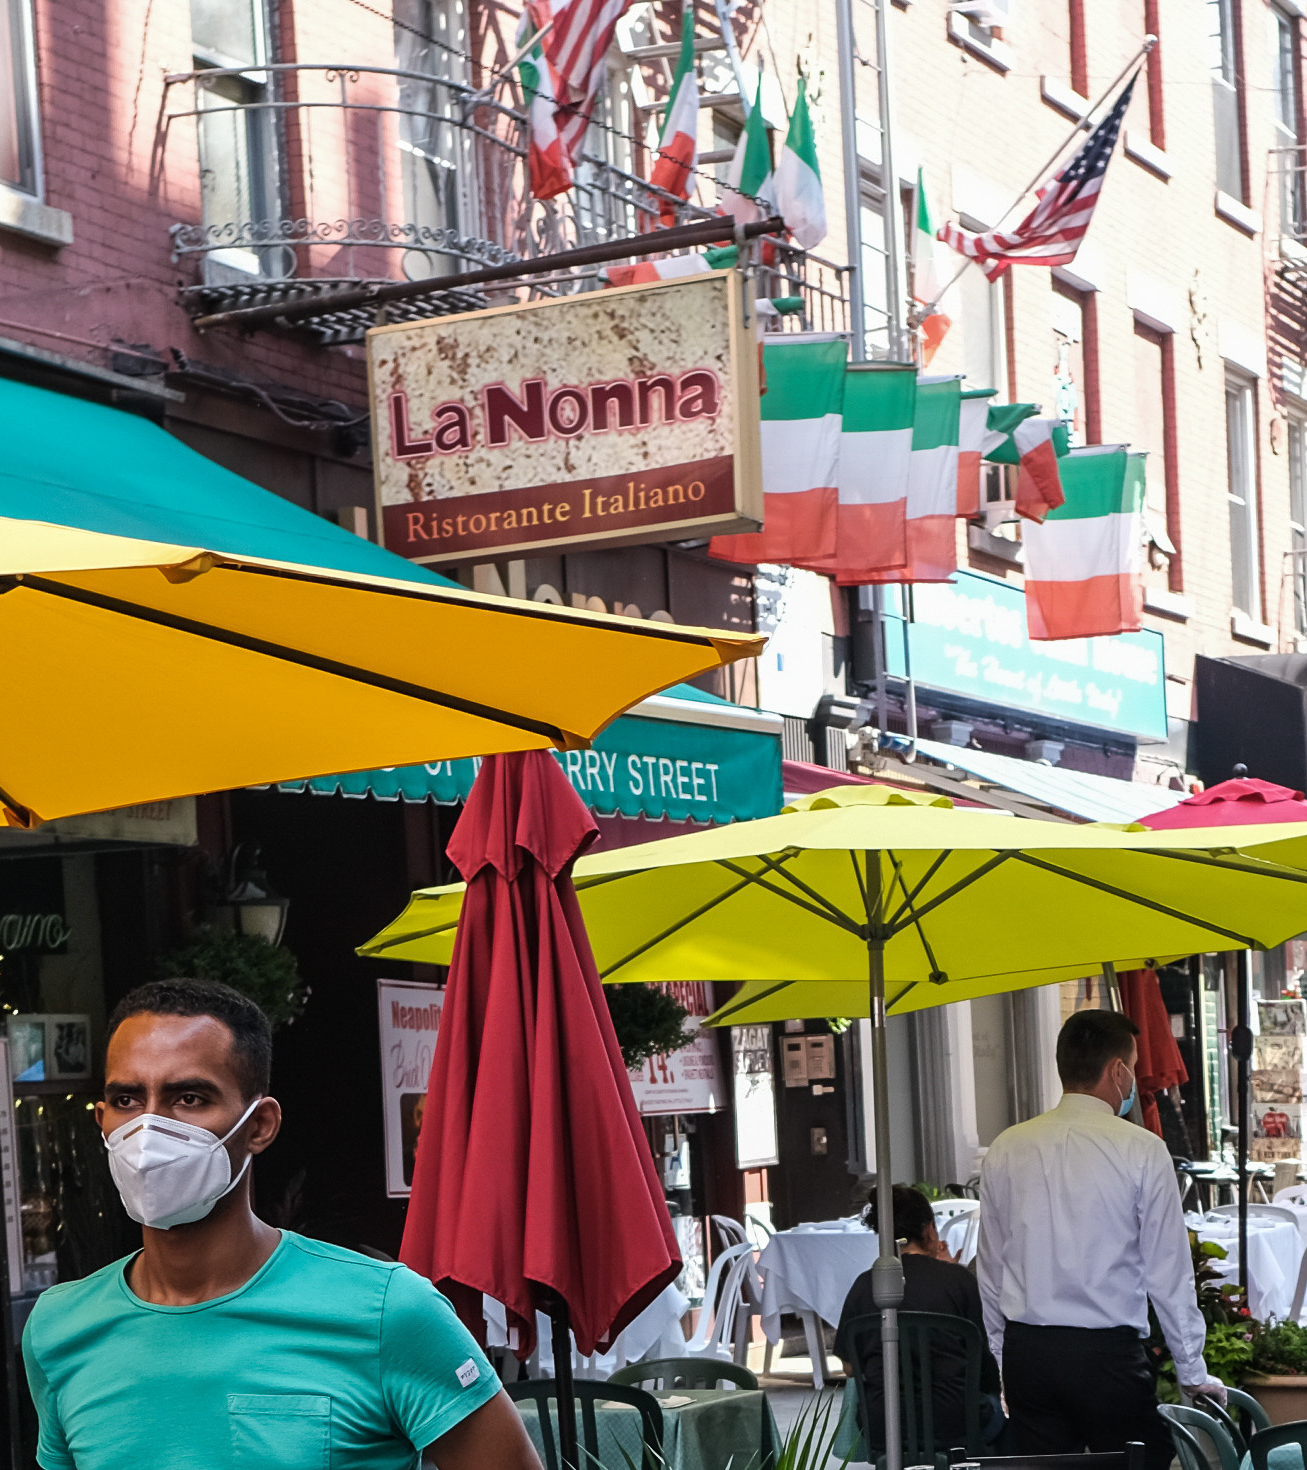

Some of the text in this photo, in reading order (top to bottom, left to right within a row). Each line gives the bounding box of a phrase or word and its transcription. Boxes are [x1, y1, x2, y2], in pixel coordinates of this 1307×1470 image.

[390, 368, 723, 460] La Nonna
[405, 501, 572, 543] Ristorante
[581, 478, 707, 519] Italiano
[626, 753, 719, 802] STREET
[731, 1026, 770, 1051] ZAGAT
